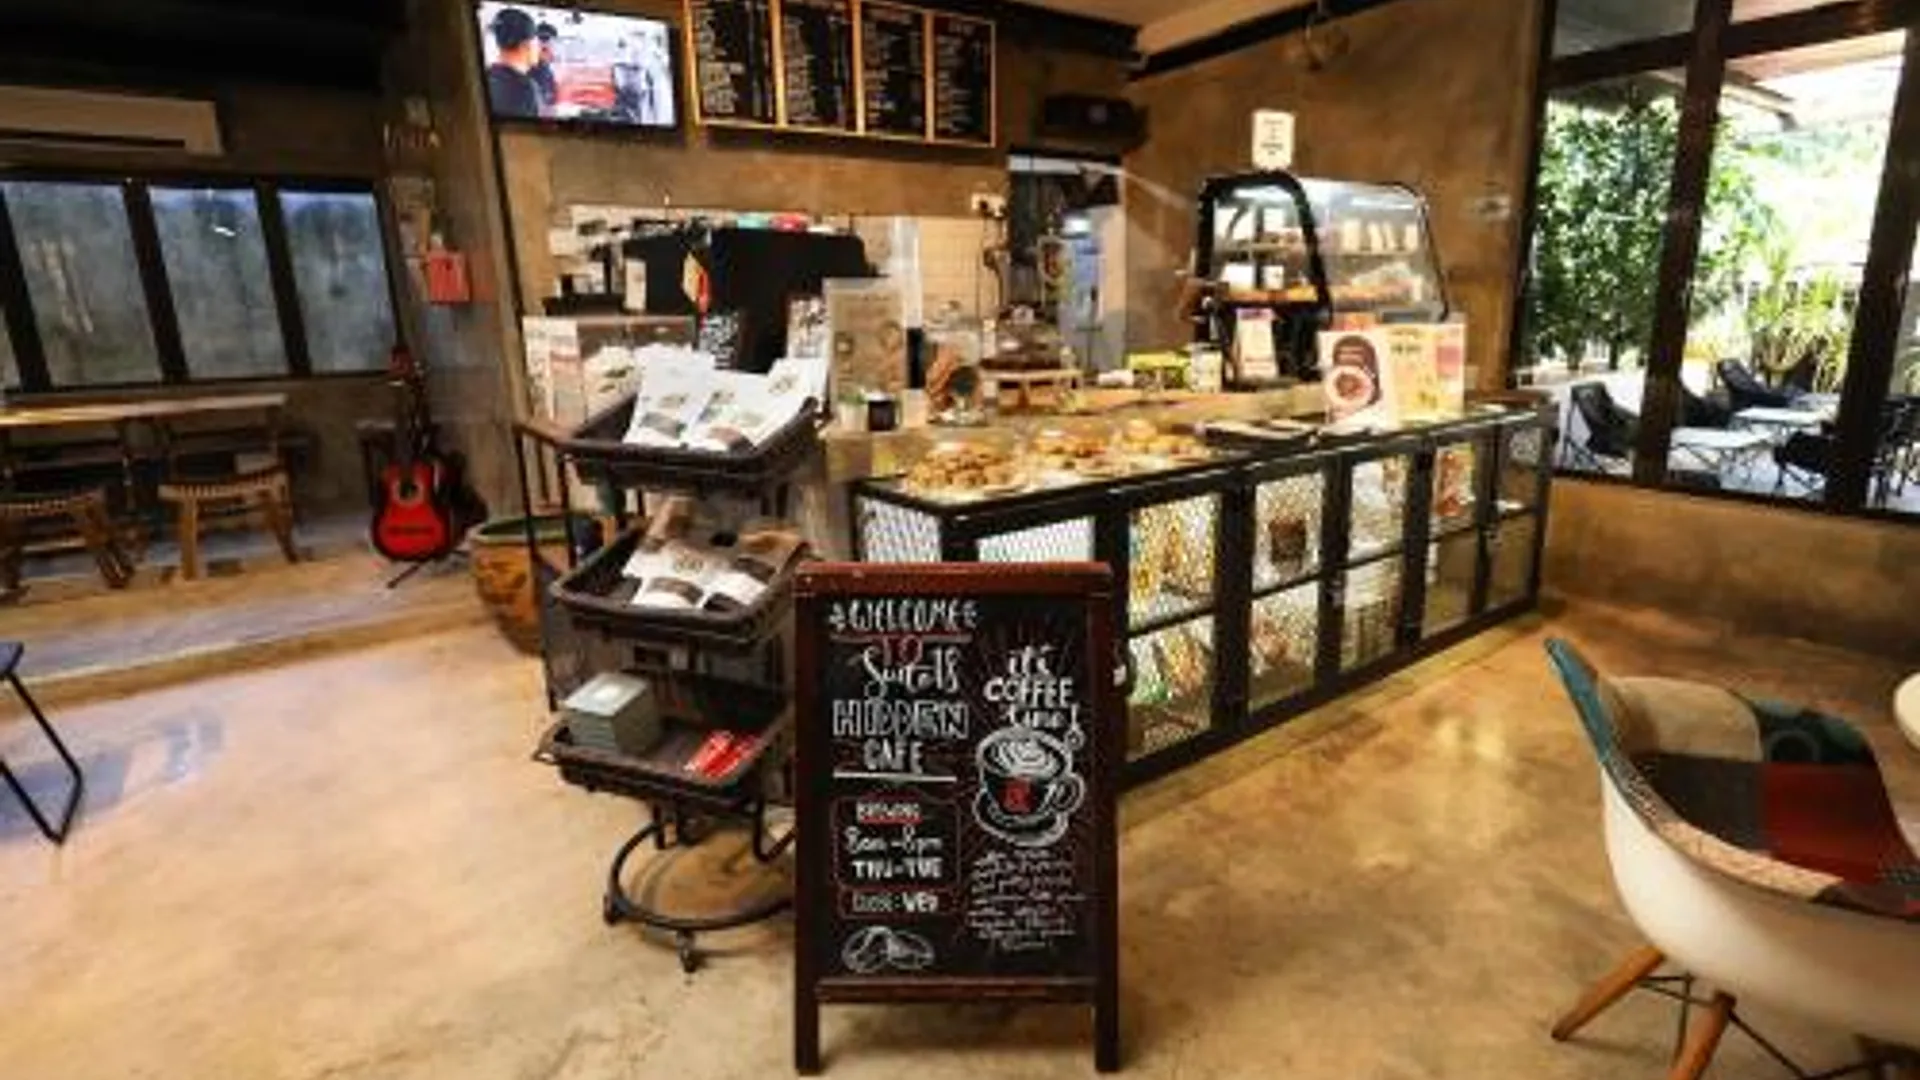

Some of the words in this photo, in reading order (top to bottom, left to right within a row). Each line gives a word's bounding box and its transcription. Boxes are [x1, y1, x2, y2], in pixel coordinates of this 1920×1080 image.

[848, 598, 961, 632] WELCOME
[983, 677, 1074, 709] COFFEE
[832, 699, 969, 740] HIDDEN
[863, 738, 924, 774] CAFE
